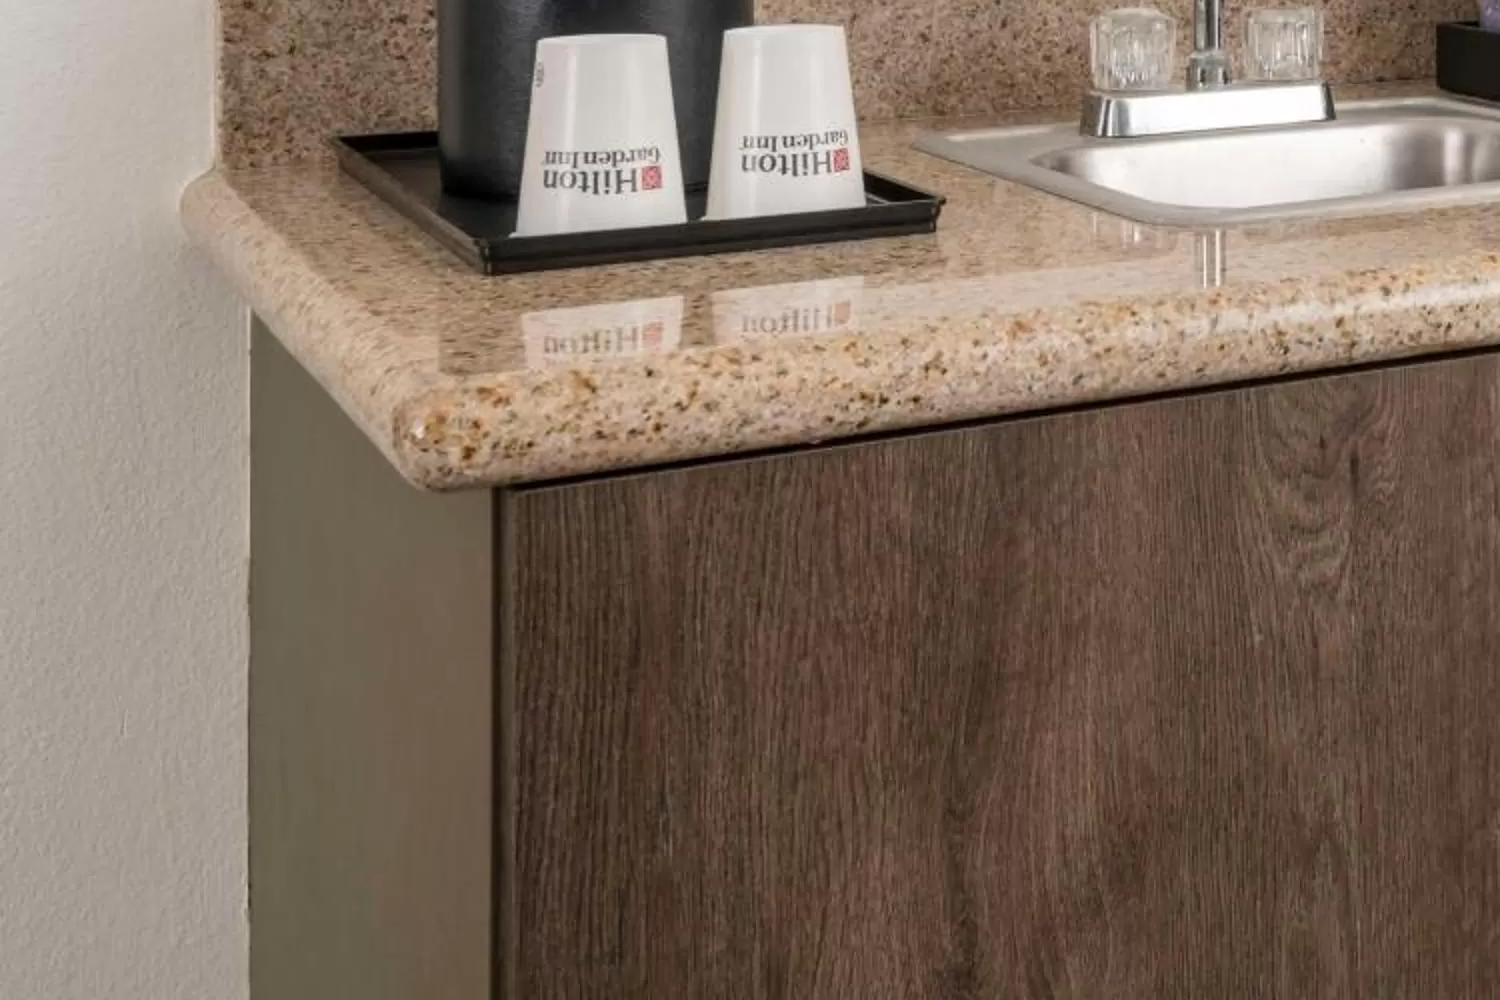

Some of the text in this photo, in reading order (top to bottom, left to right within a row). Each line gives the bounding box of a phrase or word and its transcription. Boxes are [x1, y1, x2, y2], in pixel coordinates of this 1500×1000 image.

[742, 129, 849, 153] Garden Inn
[543, 146, 662, 169] Garden Inn
[741, 150, 832, 177] Hilton
[543, 168, 638, 195] Hilton
